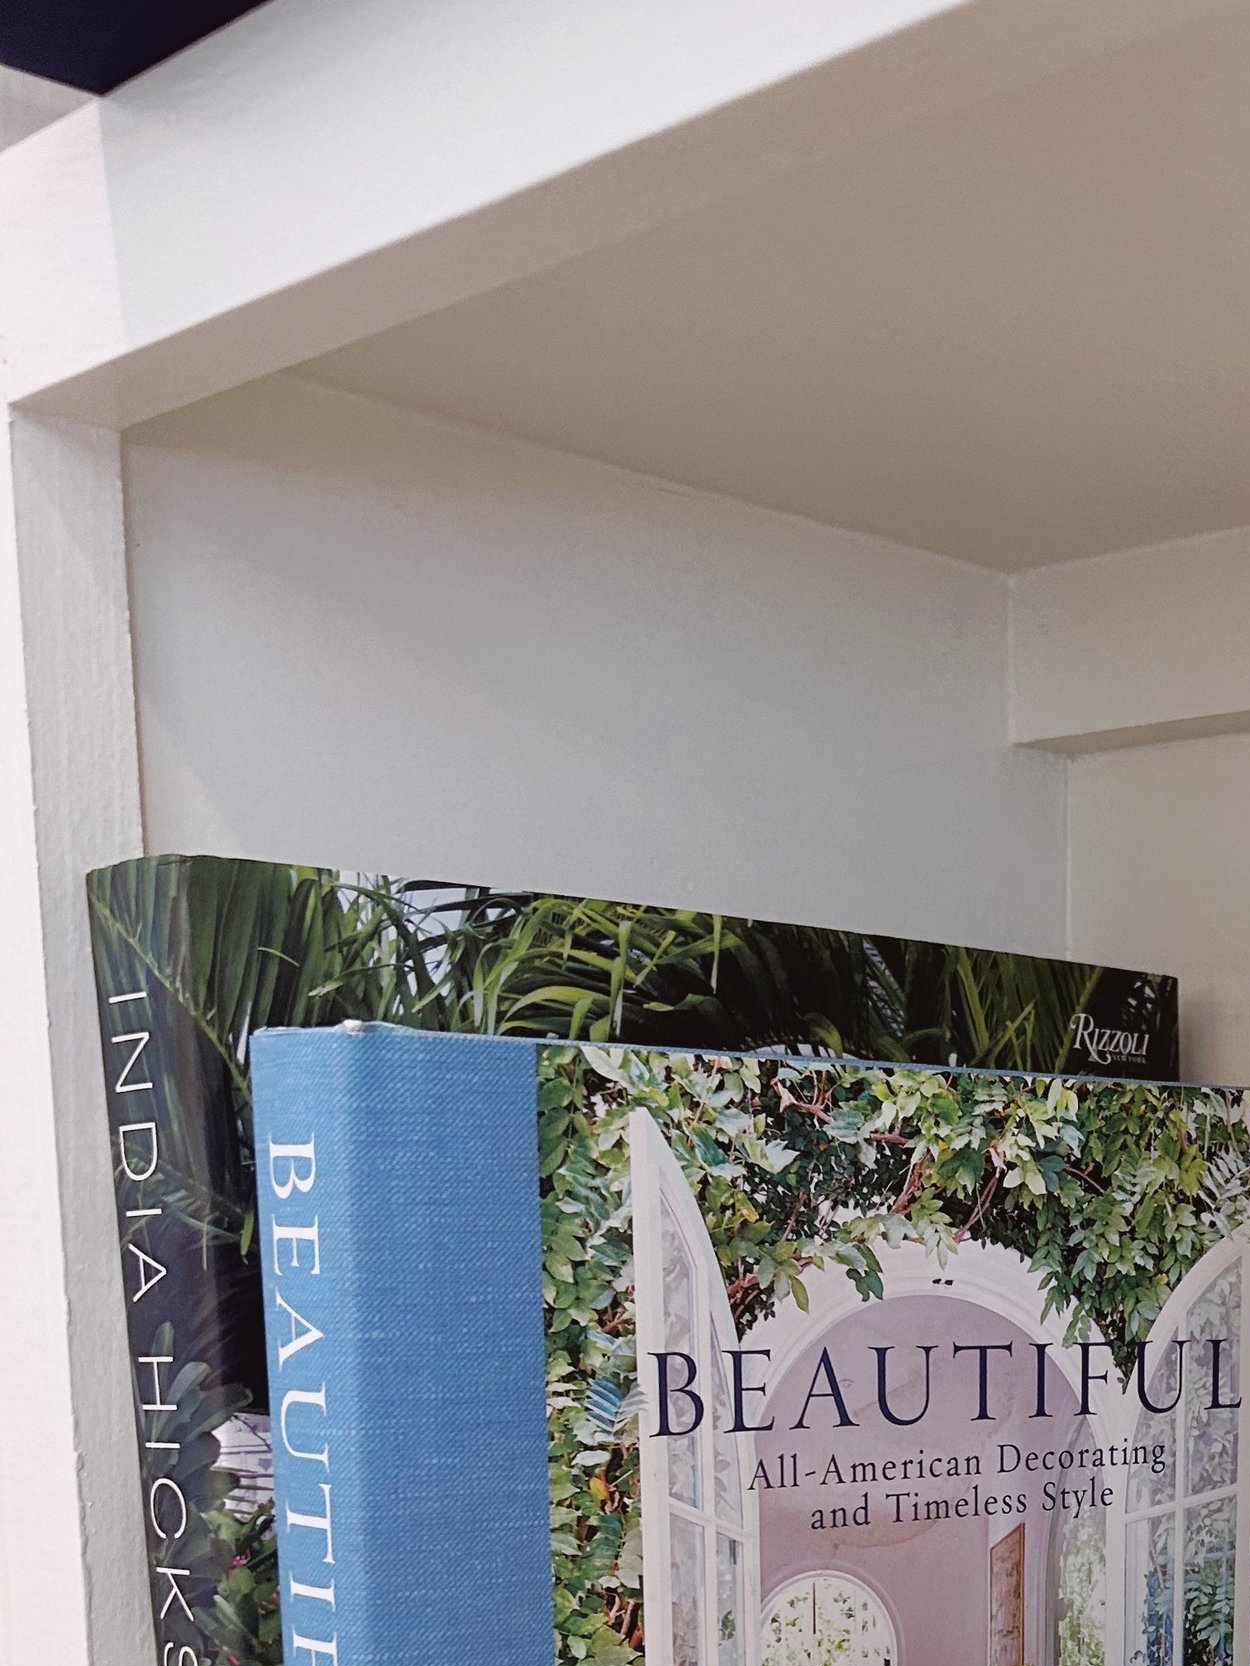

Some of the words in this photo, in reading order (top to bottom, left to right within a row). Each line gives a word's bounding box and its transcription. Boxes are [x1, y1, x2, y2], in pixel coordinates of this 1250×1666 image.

[109, 991, 168, 1303] INDIA
[646, 1338, 1243, 1439] BEAUTIFUL
[747, 1446, 982, 1491] All-American
[997, 1438, 1168, 1474] Decorating
[810, 1496, 872, 1532] and
[885, 1486, 1028, 1524] Timeless
[1042, 1477, 1115, 1516] Style
